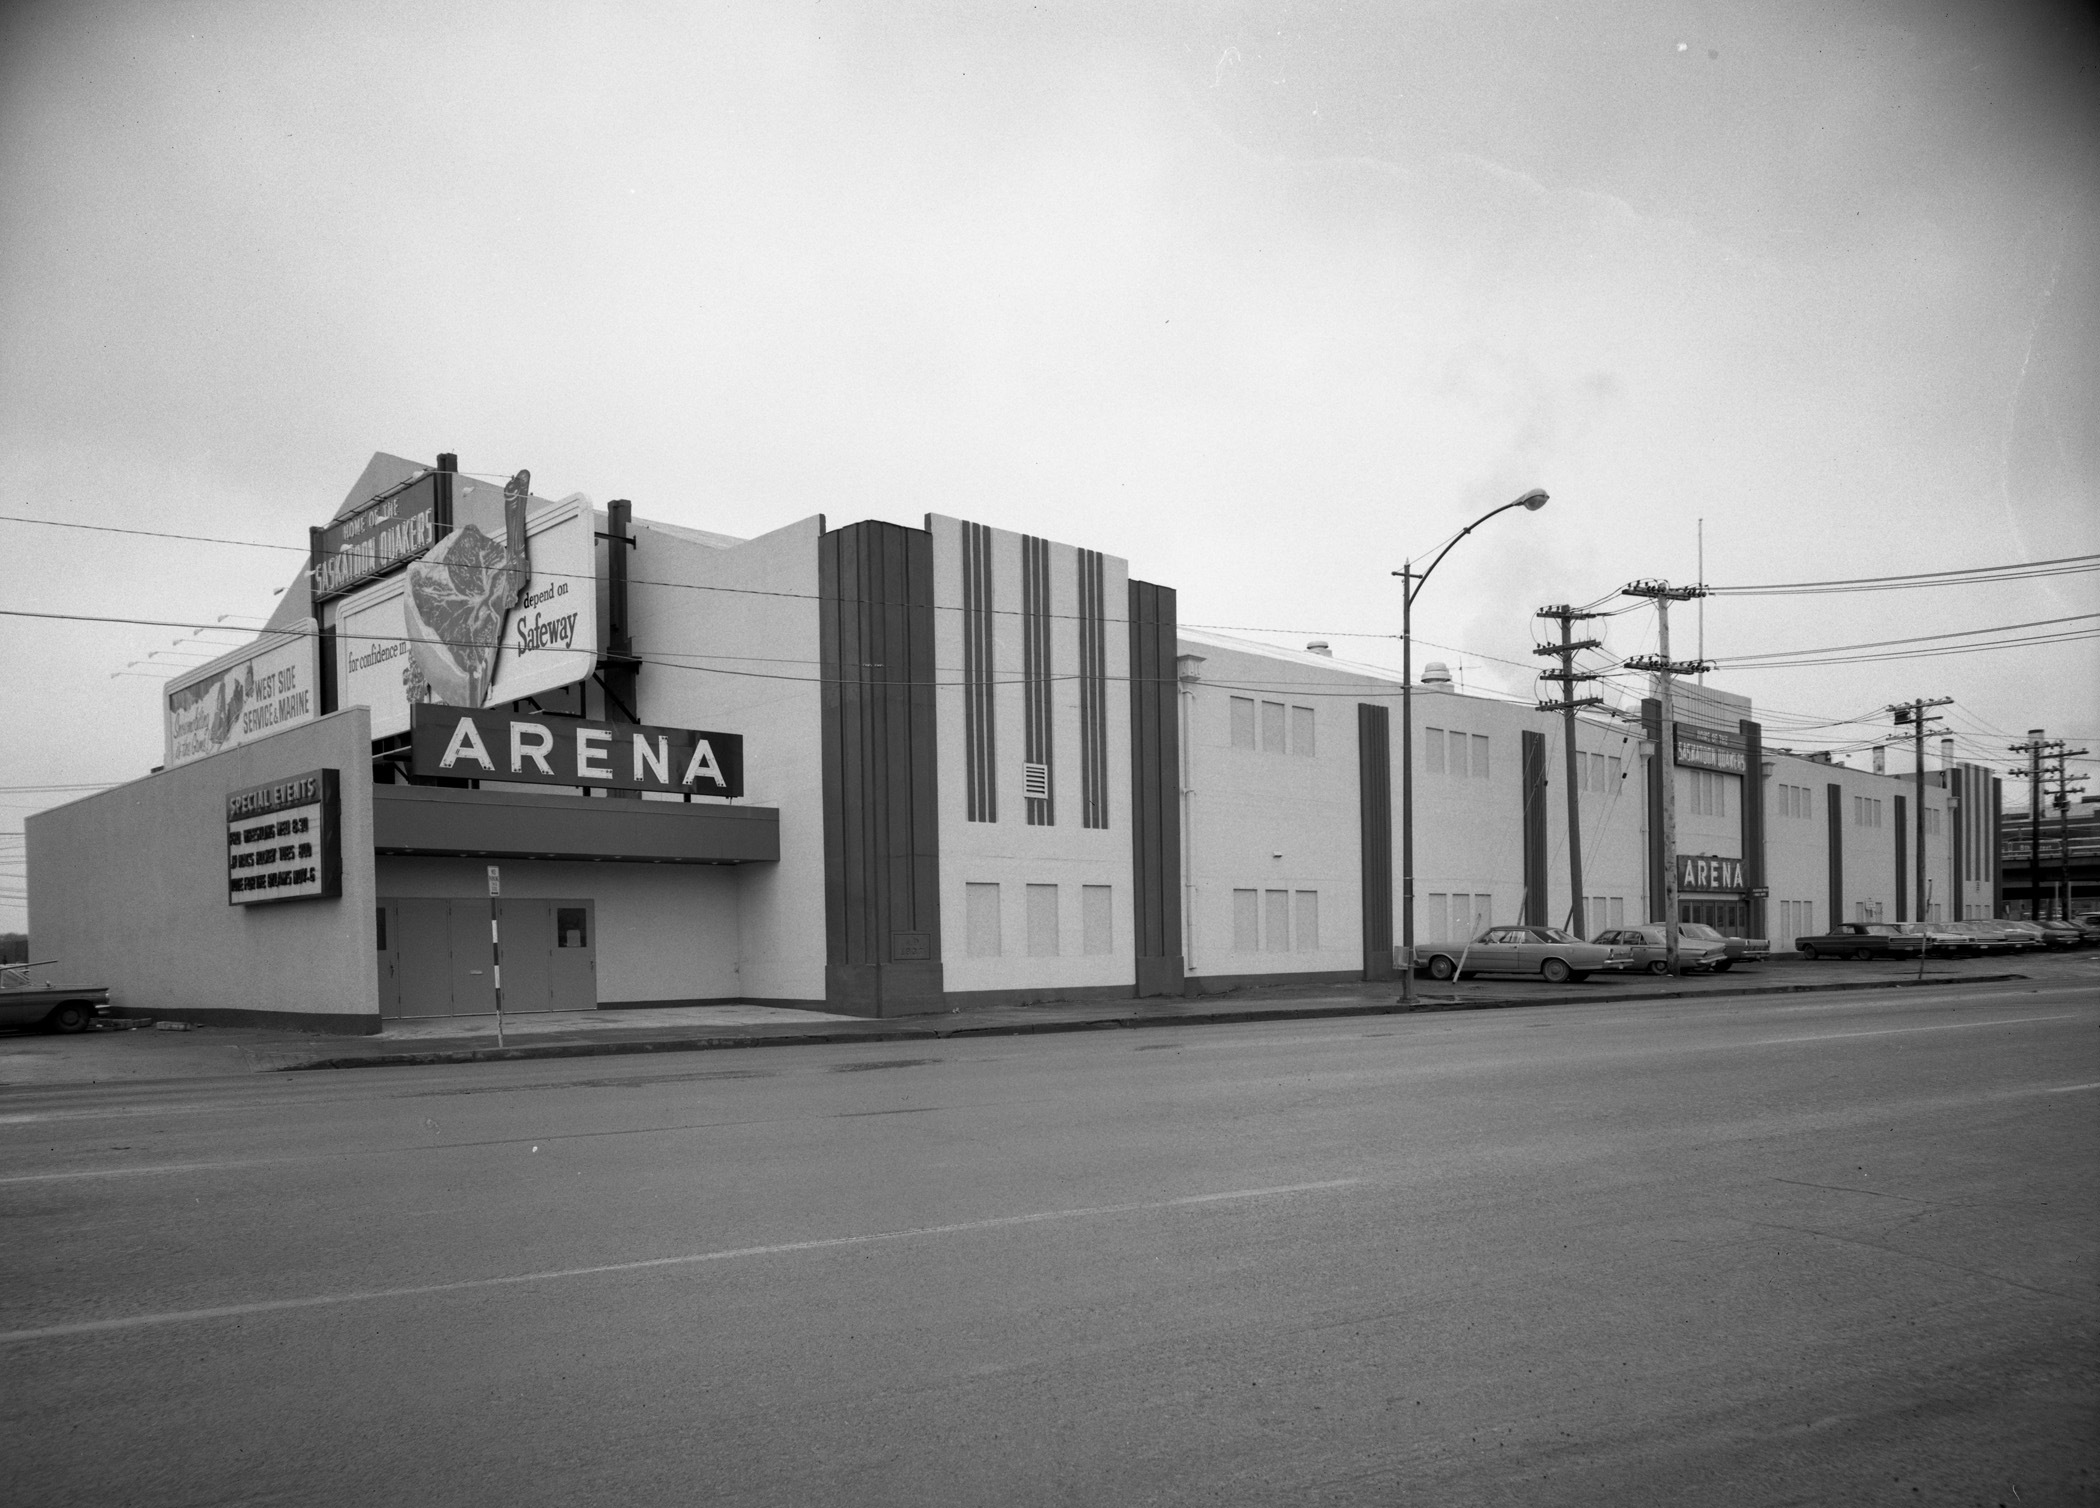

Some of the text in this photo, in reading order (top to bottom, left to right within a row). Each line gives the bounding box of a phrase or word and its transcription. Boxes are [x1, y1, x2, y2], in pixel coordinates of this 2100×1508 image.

[343, 498, 398, 540] HOME OF THE
[315, 507, 432, 596] SASKATOON QUAKERS
[523, 582, 569, 609] depend on
[517, 612, 578, 657] Safeway
[349, 651, 359, 674] for
[359, 643, 399, 667] confidence
[254, 665, 296, 703] WEST SIDE
[243, 703, 273, 734] SERVICE
[278, 690, 309, 722] MARINE
[438, 716, 727, 787] ARENA
[230, 778, 316, 814] SPECIAL EVENTS
[1683, 859, 1744, 888] ARENA
